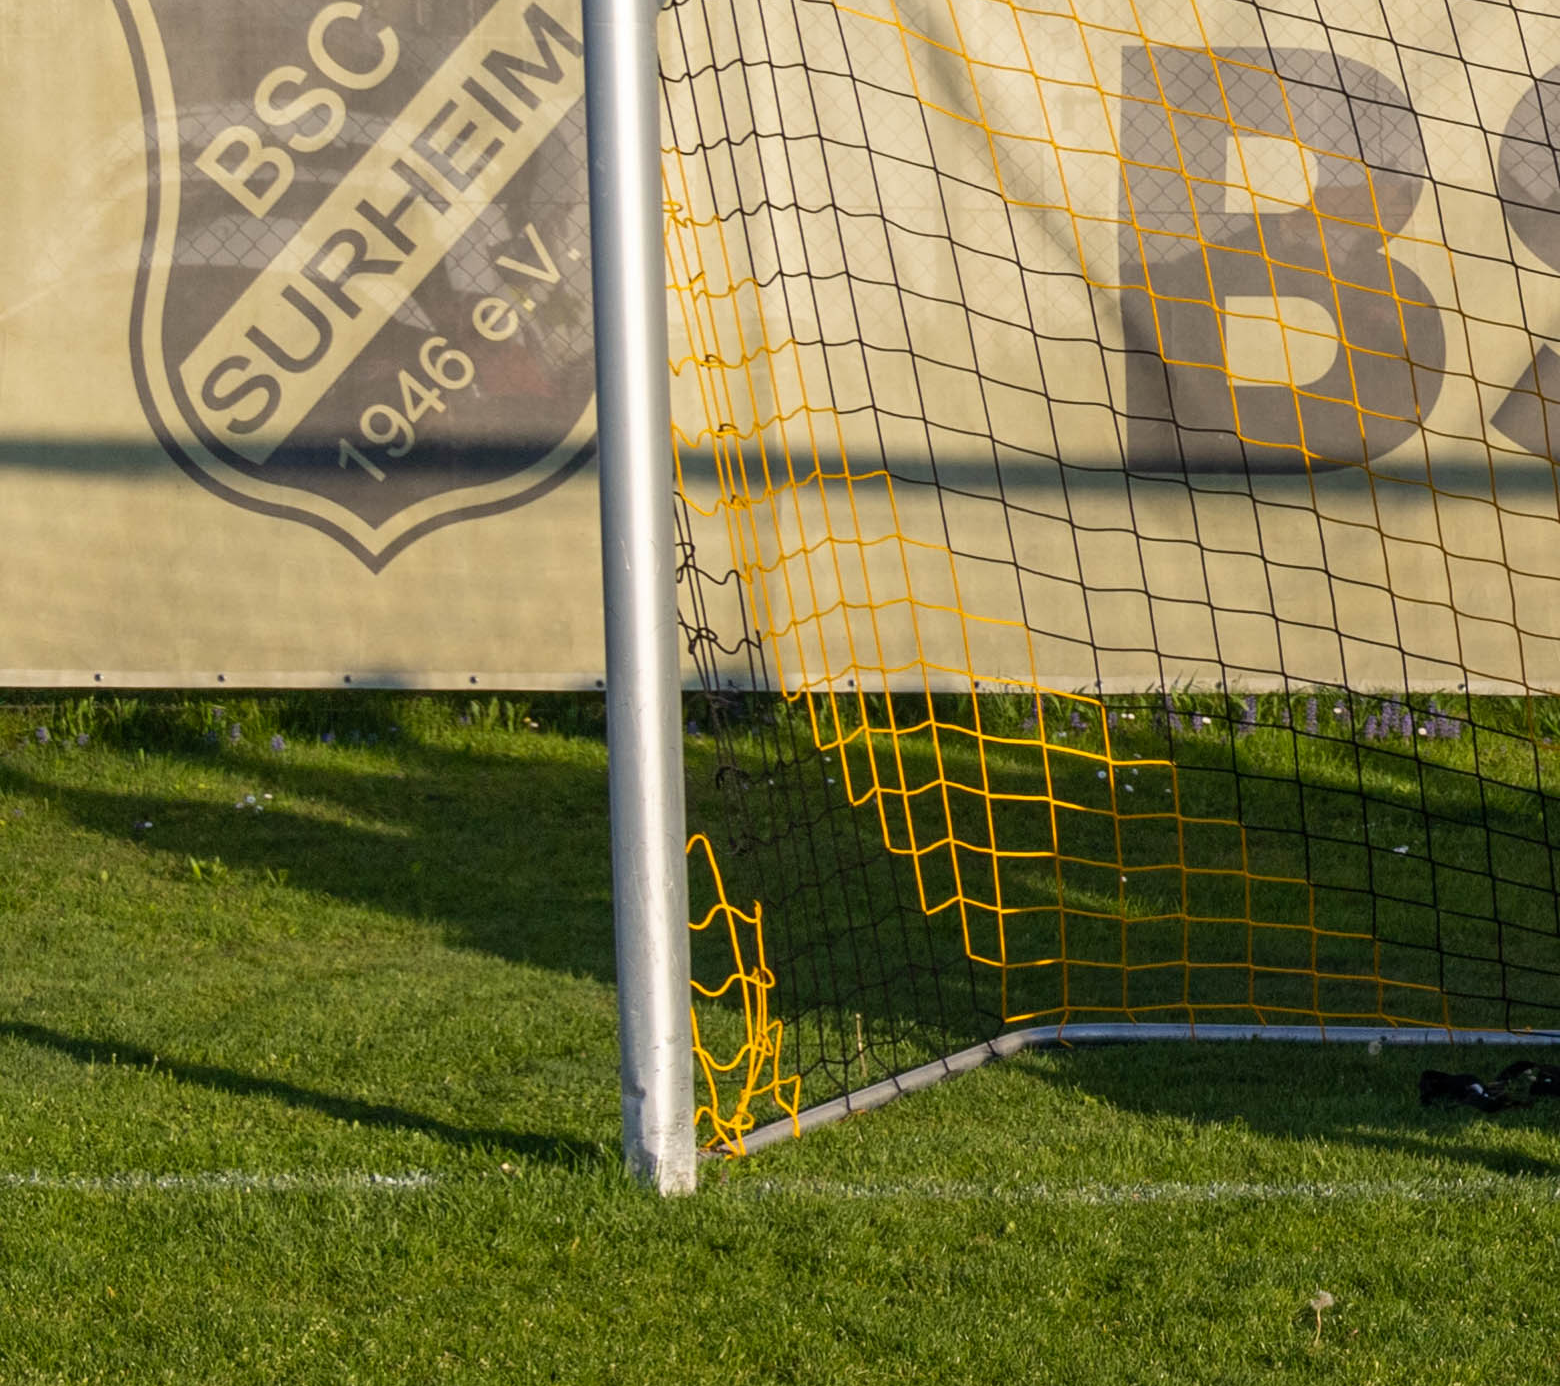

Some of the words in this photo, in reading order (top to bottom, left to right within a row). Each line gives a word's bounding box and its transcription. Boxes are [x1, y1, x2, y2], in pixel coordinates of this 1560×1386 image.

[195, 1, 400, 219] BSC
[201, 2, 584, 435] SURHEIM
[338, 337, 475, 482] 1946
[473, 224, 581, 343] e.V.
